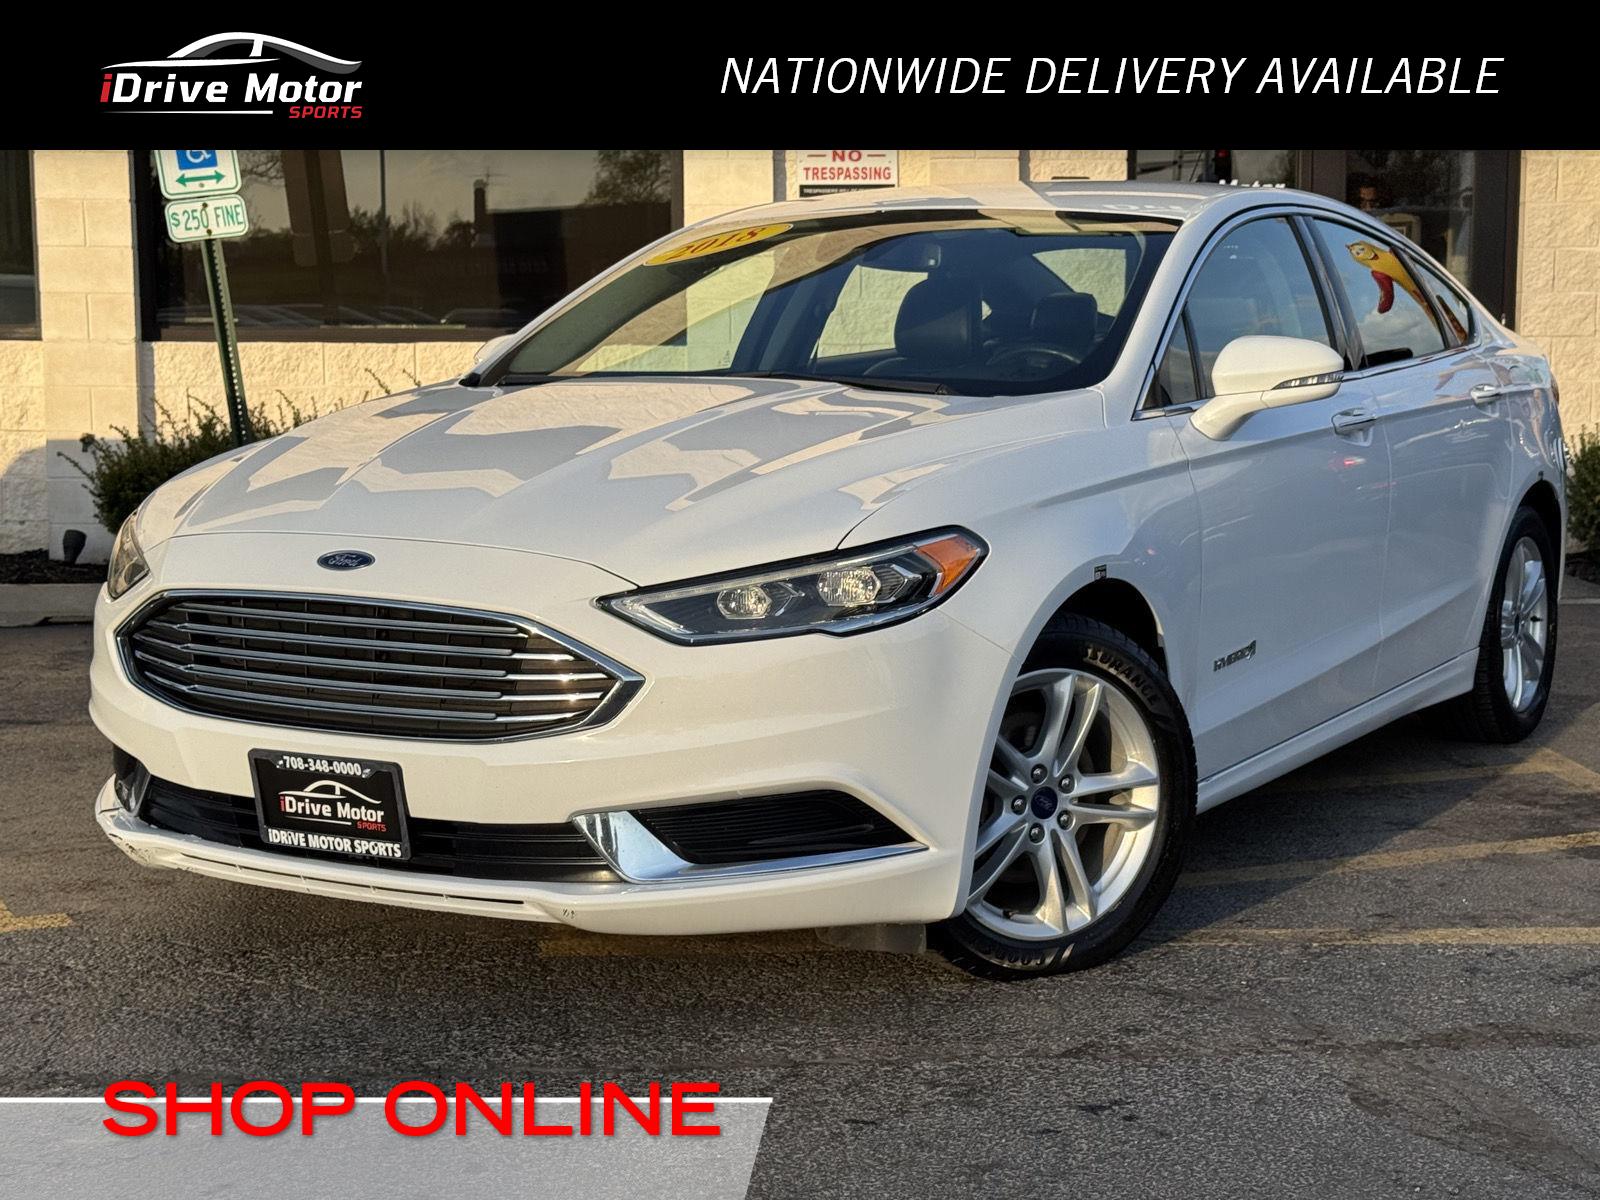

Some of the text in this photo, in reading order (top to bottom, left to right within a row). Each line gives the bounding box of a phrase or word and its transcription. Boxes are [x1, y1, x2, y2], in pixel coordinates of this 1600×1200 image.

[831, 150, 863, 162] NO
[803, 166, 892, 181] TRESPASSING
[213, 204, 244, 228] FINE
[283, 755, 362, 777] 708-348-0000
[279, 796, 385, 823] iDrive Motor
[356, 821, 387, 833] SPORTS
[307, 833, 352, 853] MOTOR
[353, 838, 402, 858] SPORTS
